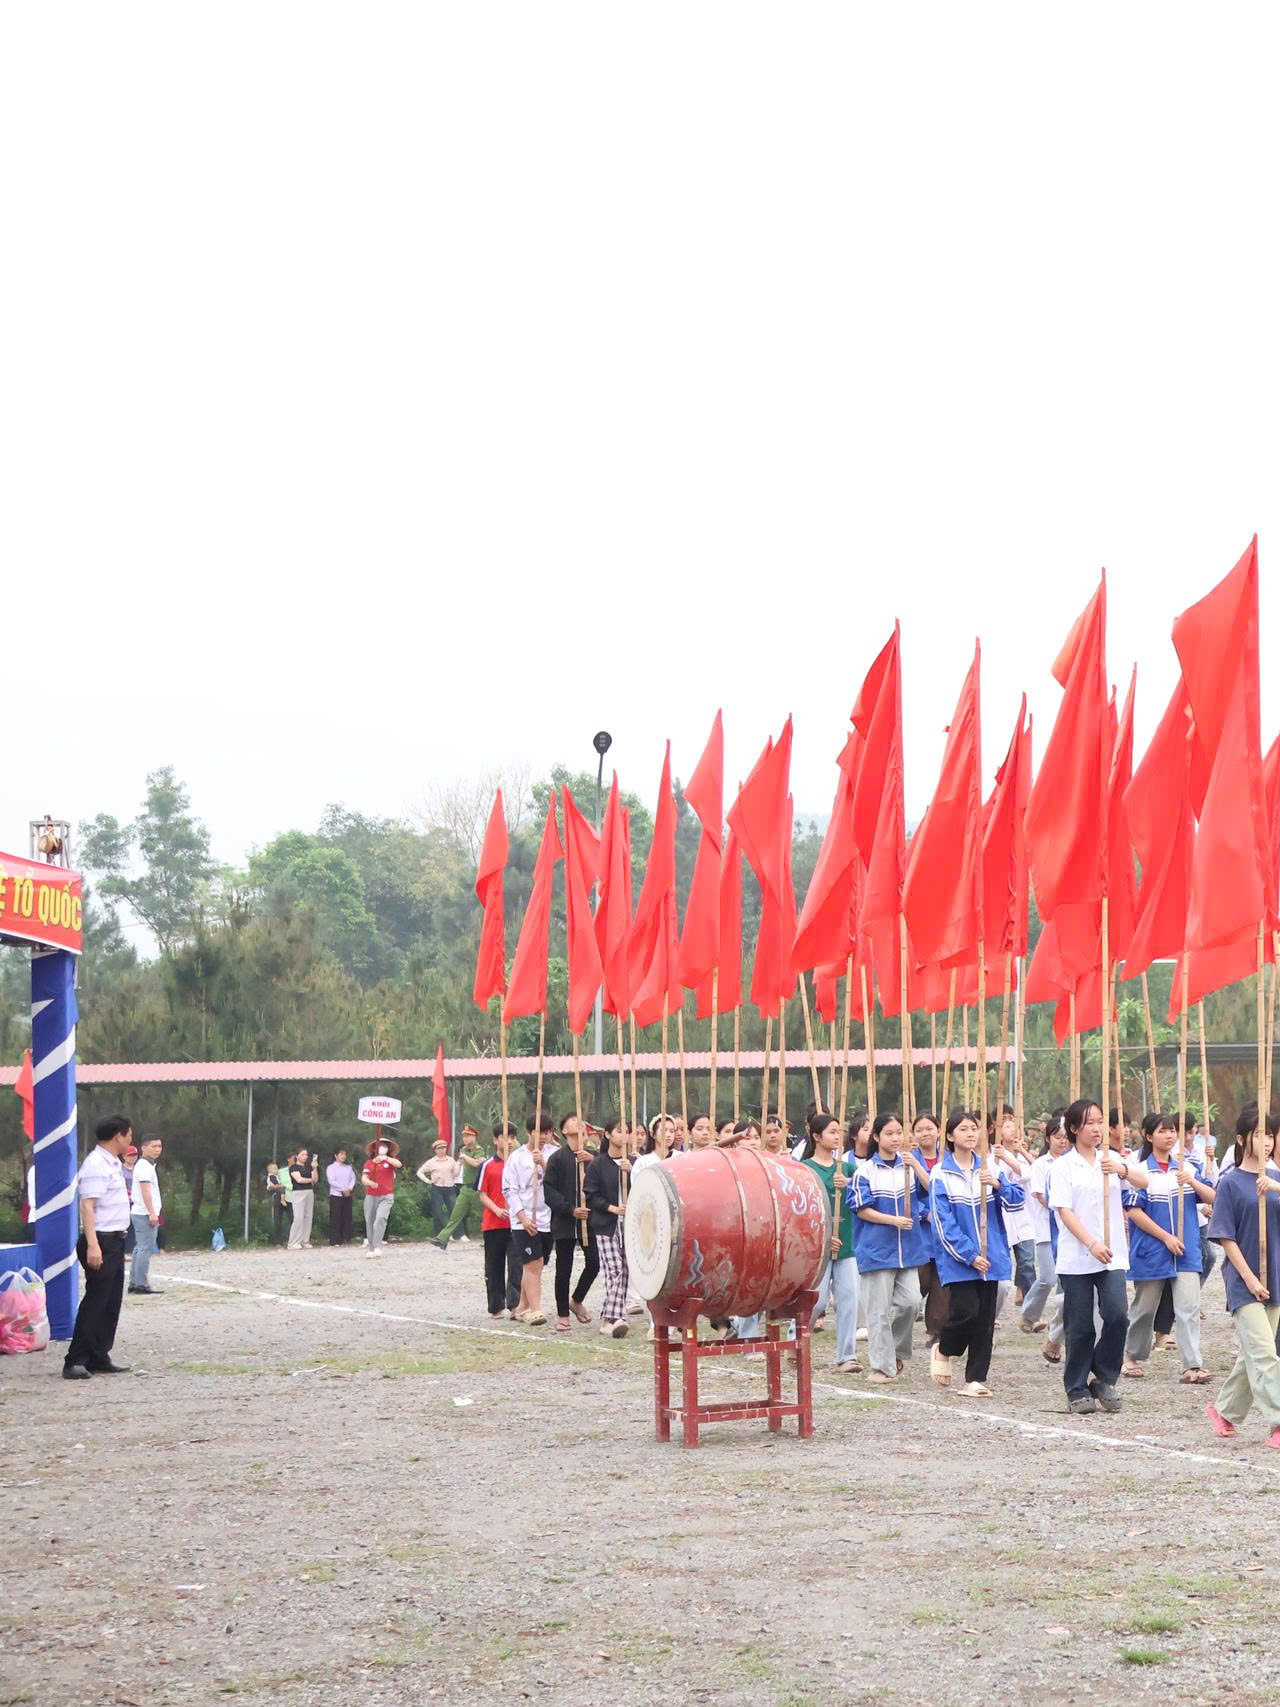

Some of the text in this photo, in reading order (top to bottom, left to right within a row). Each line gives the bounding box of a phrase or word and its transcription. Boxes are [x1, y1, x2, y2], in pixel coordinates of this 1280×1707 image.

[13, 867, 34, 918] TỔ
[38, 880, 82, 932] QUỐC
[362, 1109, 397, 1119] CÔNG AN
